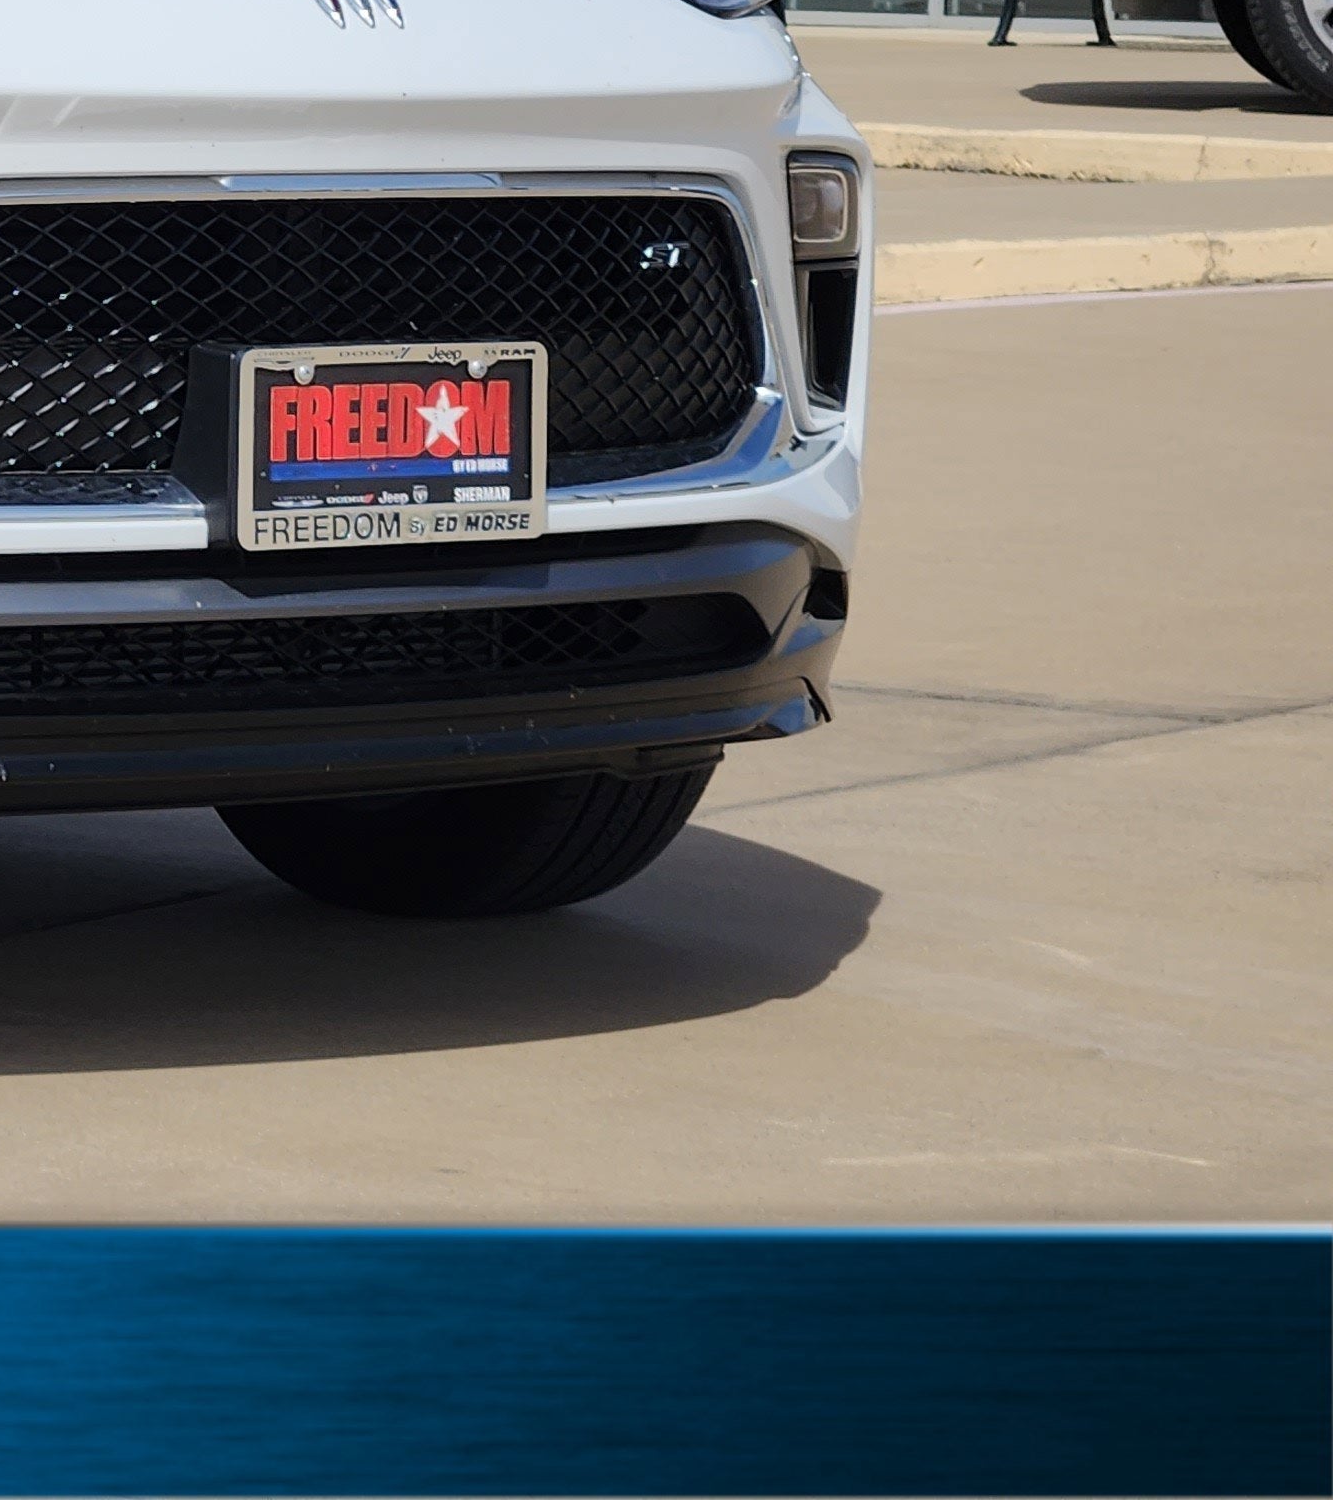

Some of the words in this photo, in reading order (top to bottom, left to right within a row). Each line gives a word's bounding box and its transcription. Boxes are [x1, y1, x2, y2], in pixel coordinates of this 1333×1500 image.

[427, 346, 462, 362] Jeep
[500, 348, 537, 356] RAM
[270, 380, 511, 462] FREEDOM
[377, 491, 410, 505] Jeep
[453, 486, 511, 503] SHERMAN
[253, 512, 401, 545] FREEDOM
[434, 516, 459, 533] ED
[465, 513, 531, 532] MORSE
